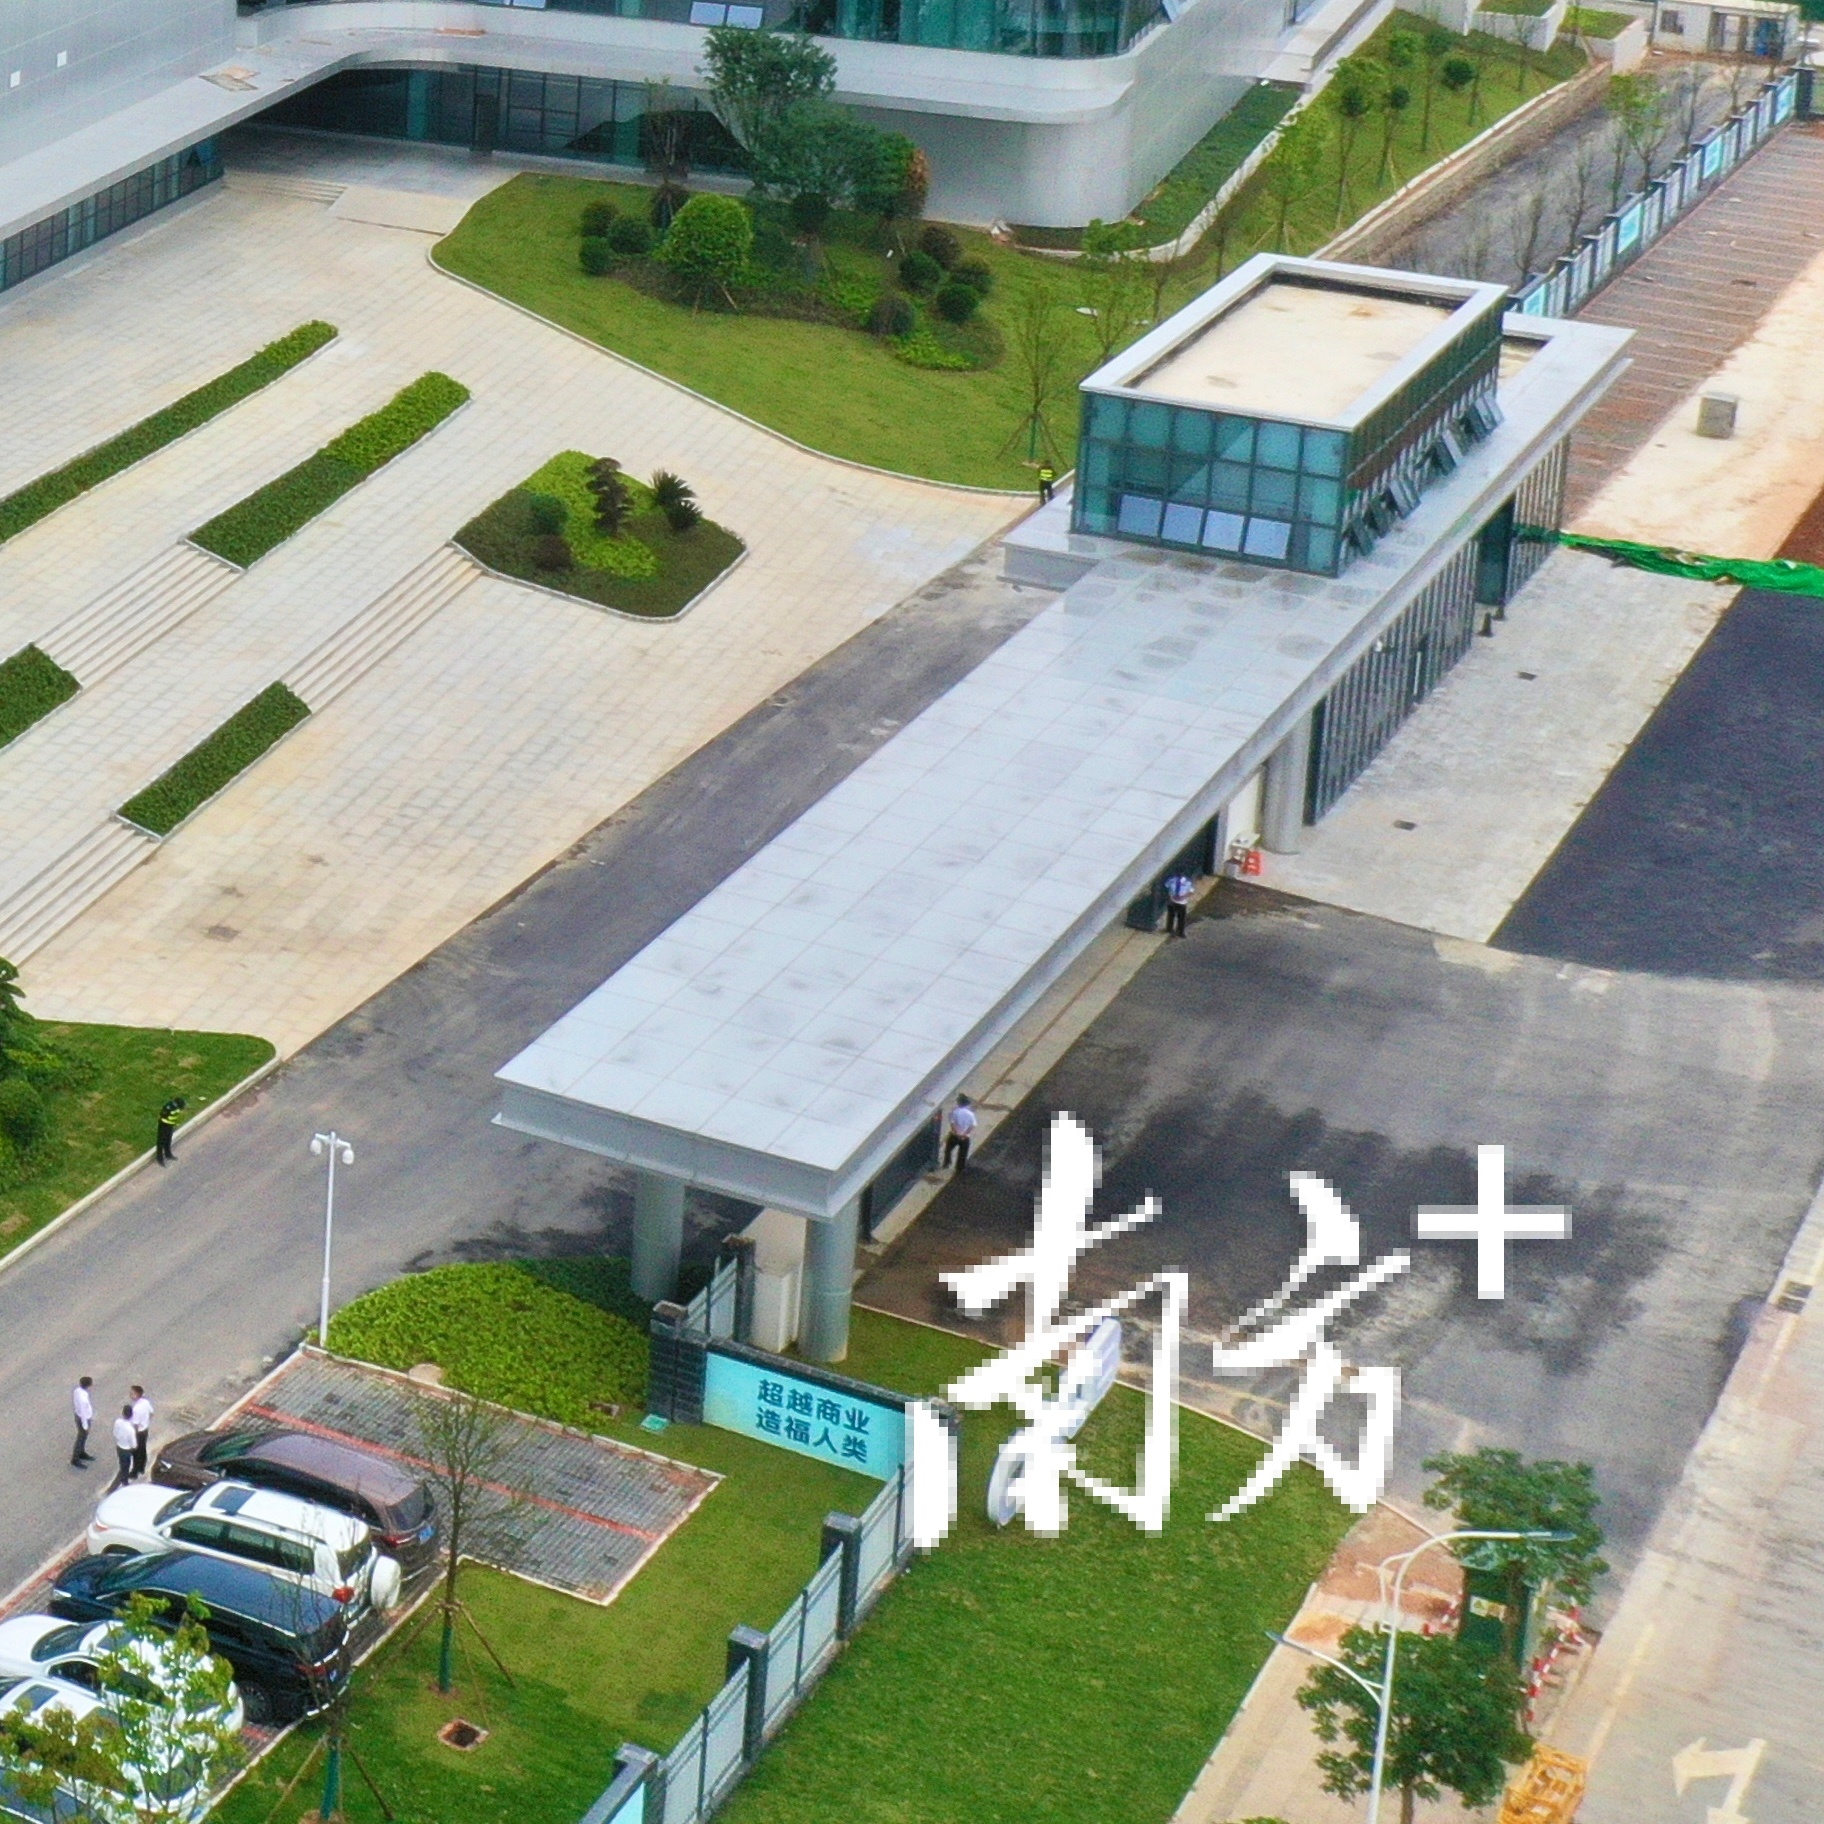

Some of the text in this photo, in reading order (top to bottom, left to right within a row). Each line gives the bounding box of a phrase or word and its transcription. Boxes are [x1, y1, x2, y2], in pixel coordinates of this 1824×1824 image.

[755, 1405, 868, 1464] 造福人类
[756, 1379, 870, 1436] 超越商业
